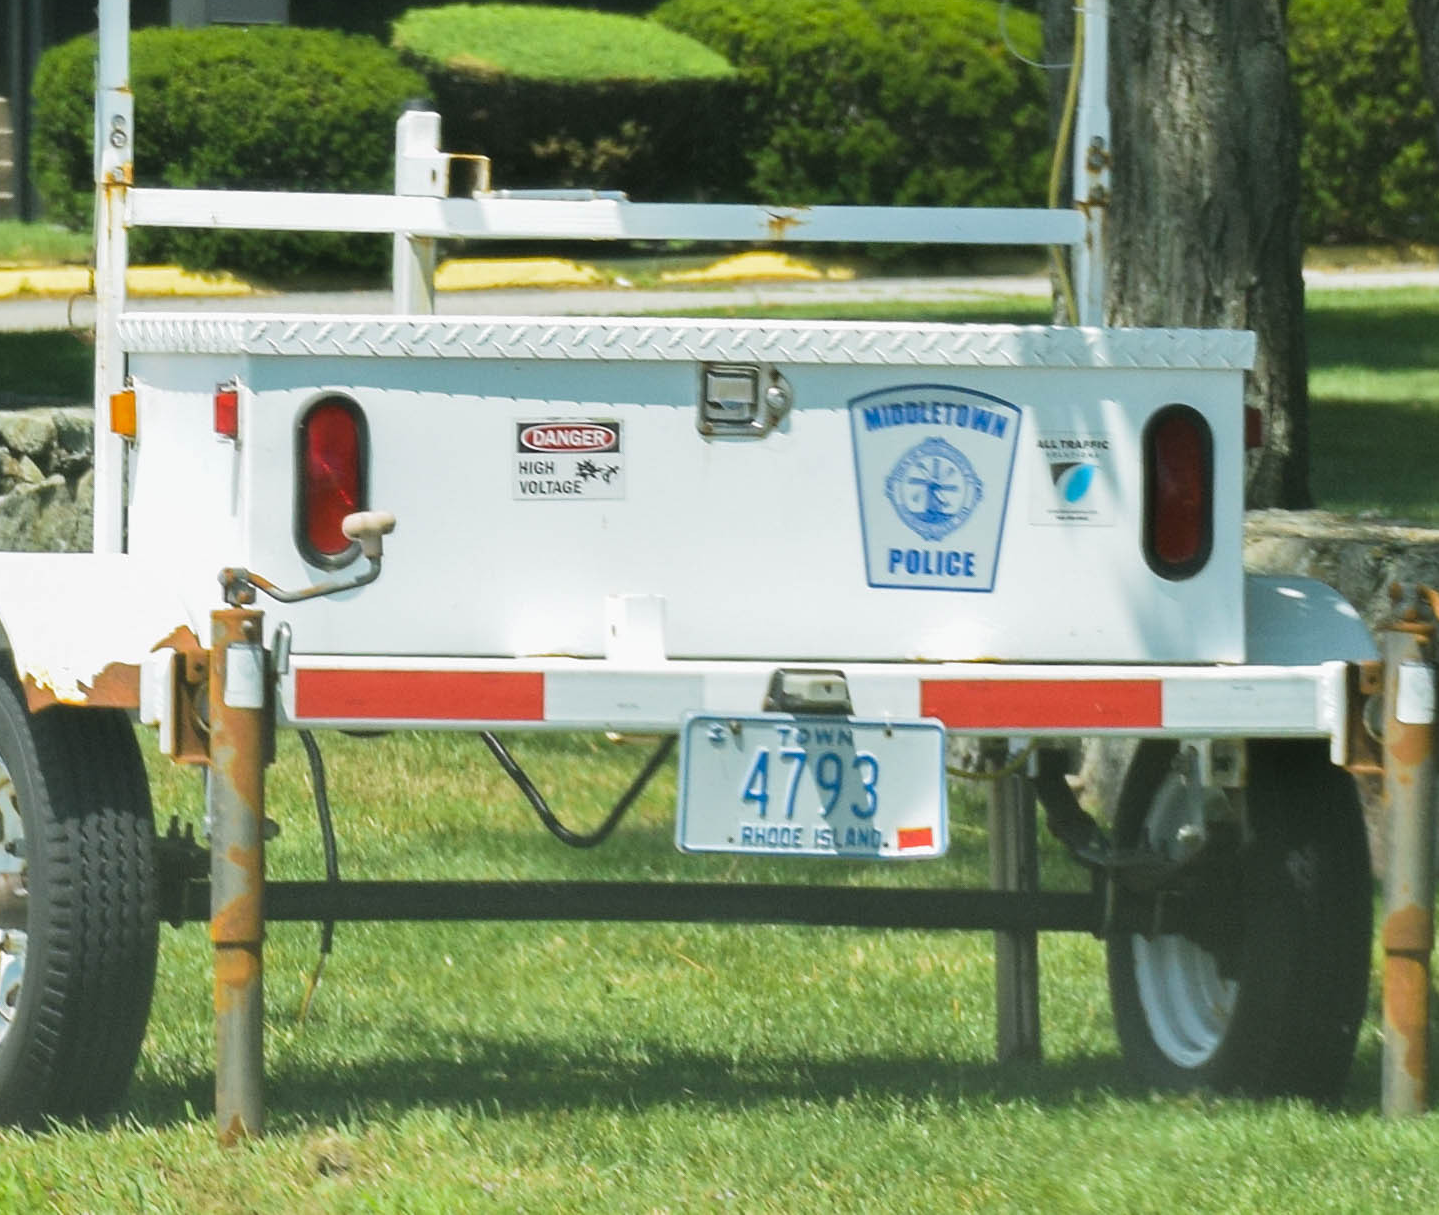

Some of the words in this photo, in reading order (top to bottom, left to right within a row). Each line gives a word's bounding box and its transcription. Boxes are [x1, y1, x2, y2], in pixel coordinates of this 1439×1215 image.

[863, 401, 1009, 439] MIDDLETOWN
[532, 429, 606, 447] DANGER
[1037, 439, 1058, 449] ALL
[1060, 439, 1110, 450] TRAFFIC
[519, 461, 554, 474] HIGH
[520, 480, 583, 494] VOLTAGE
[888, 548, 976, 577] POLICE
[775, 726, 854, 747] TOWN
[741, 748, 880, 820] 4793
[741, 826, 804, 848] RHODE
[813, 827, 882, 849] ISLAND
